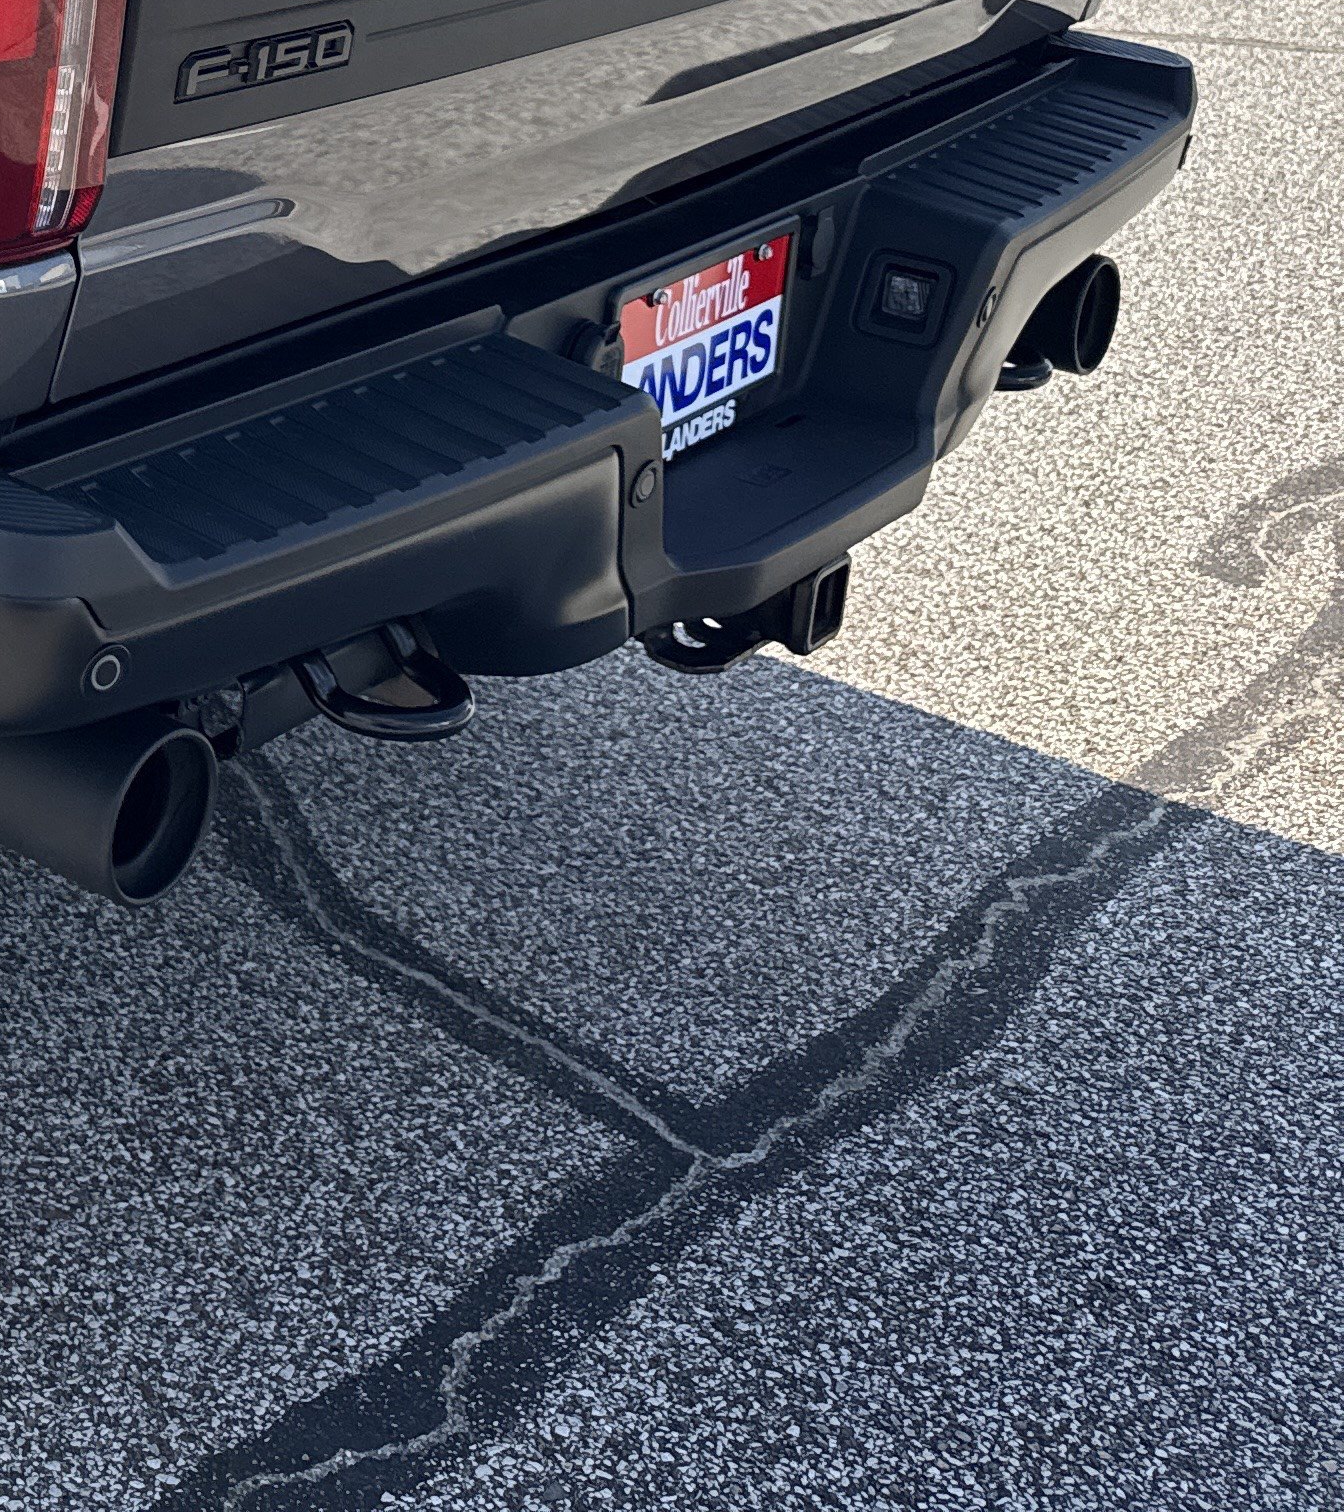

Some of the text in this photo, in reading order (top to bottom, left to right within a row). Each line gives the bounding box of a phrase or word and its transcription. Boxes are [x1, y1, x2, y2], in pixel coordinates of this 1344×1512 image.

[178, 21, 354, 100] F-150
[655, 254, 751, 347] Collierville
[639, 308, 774, 414] ANDERS
[662, 398, 737, 461] LANDERS
